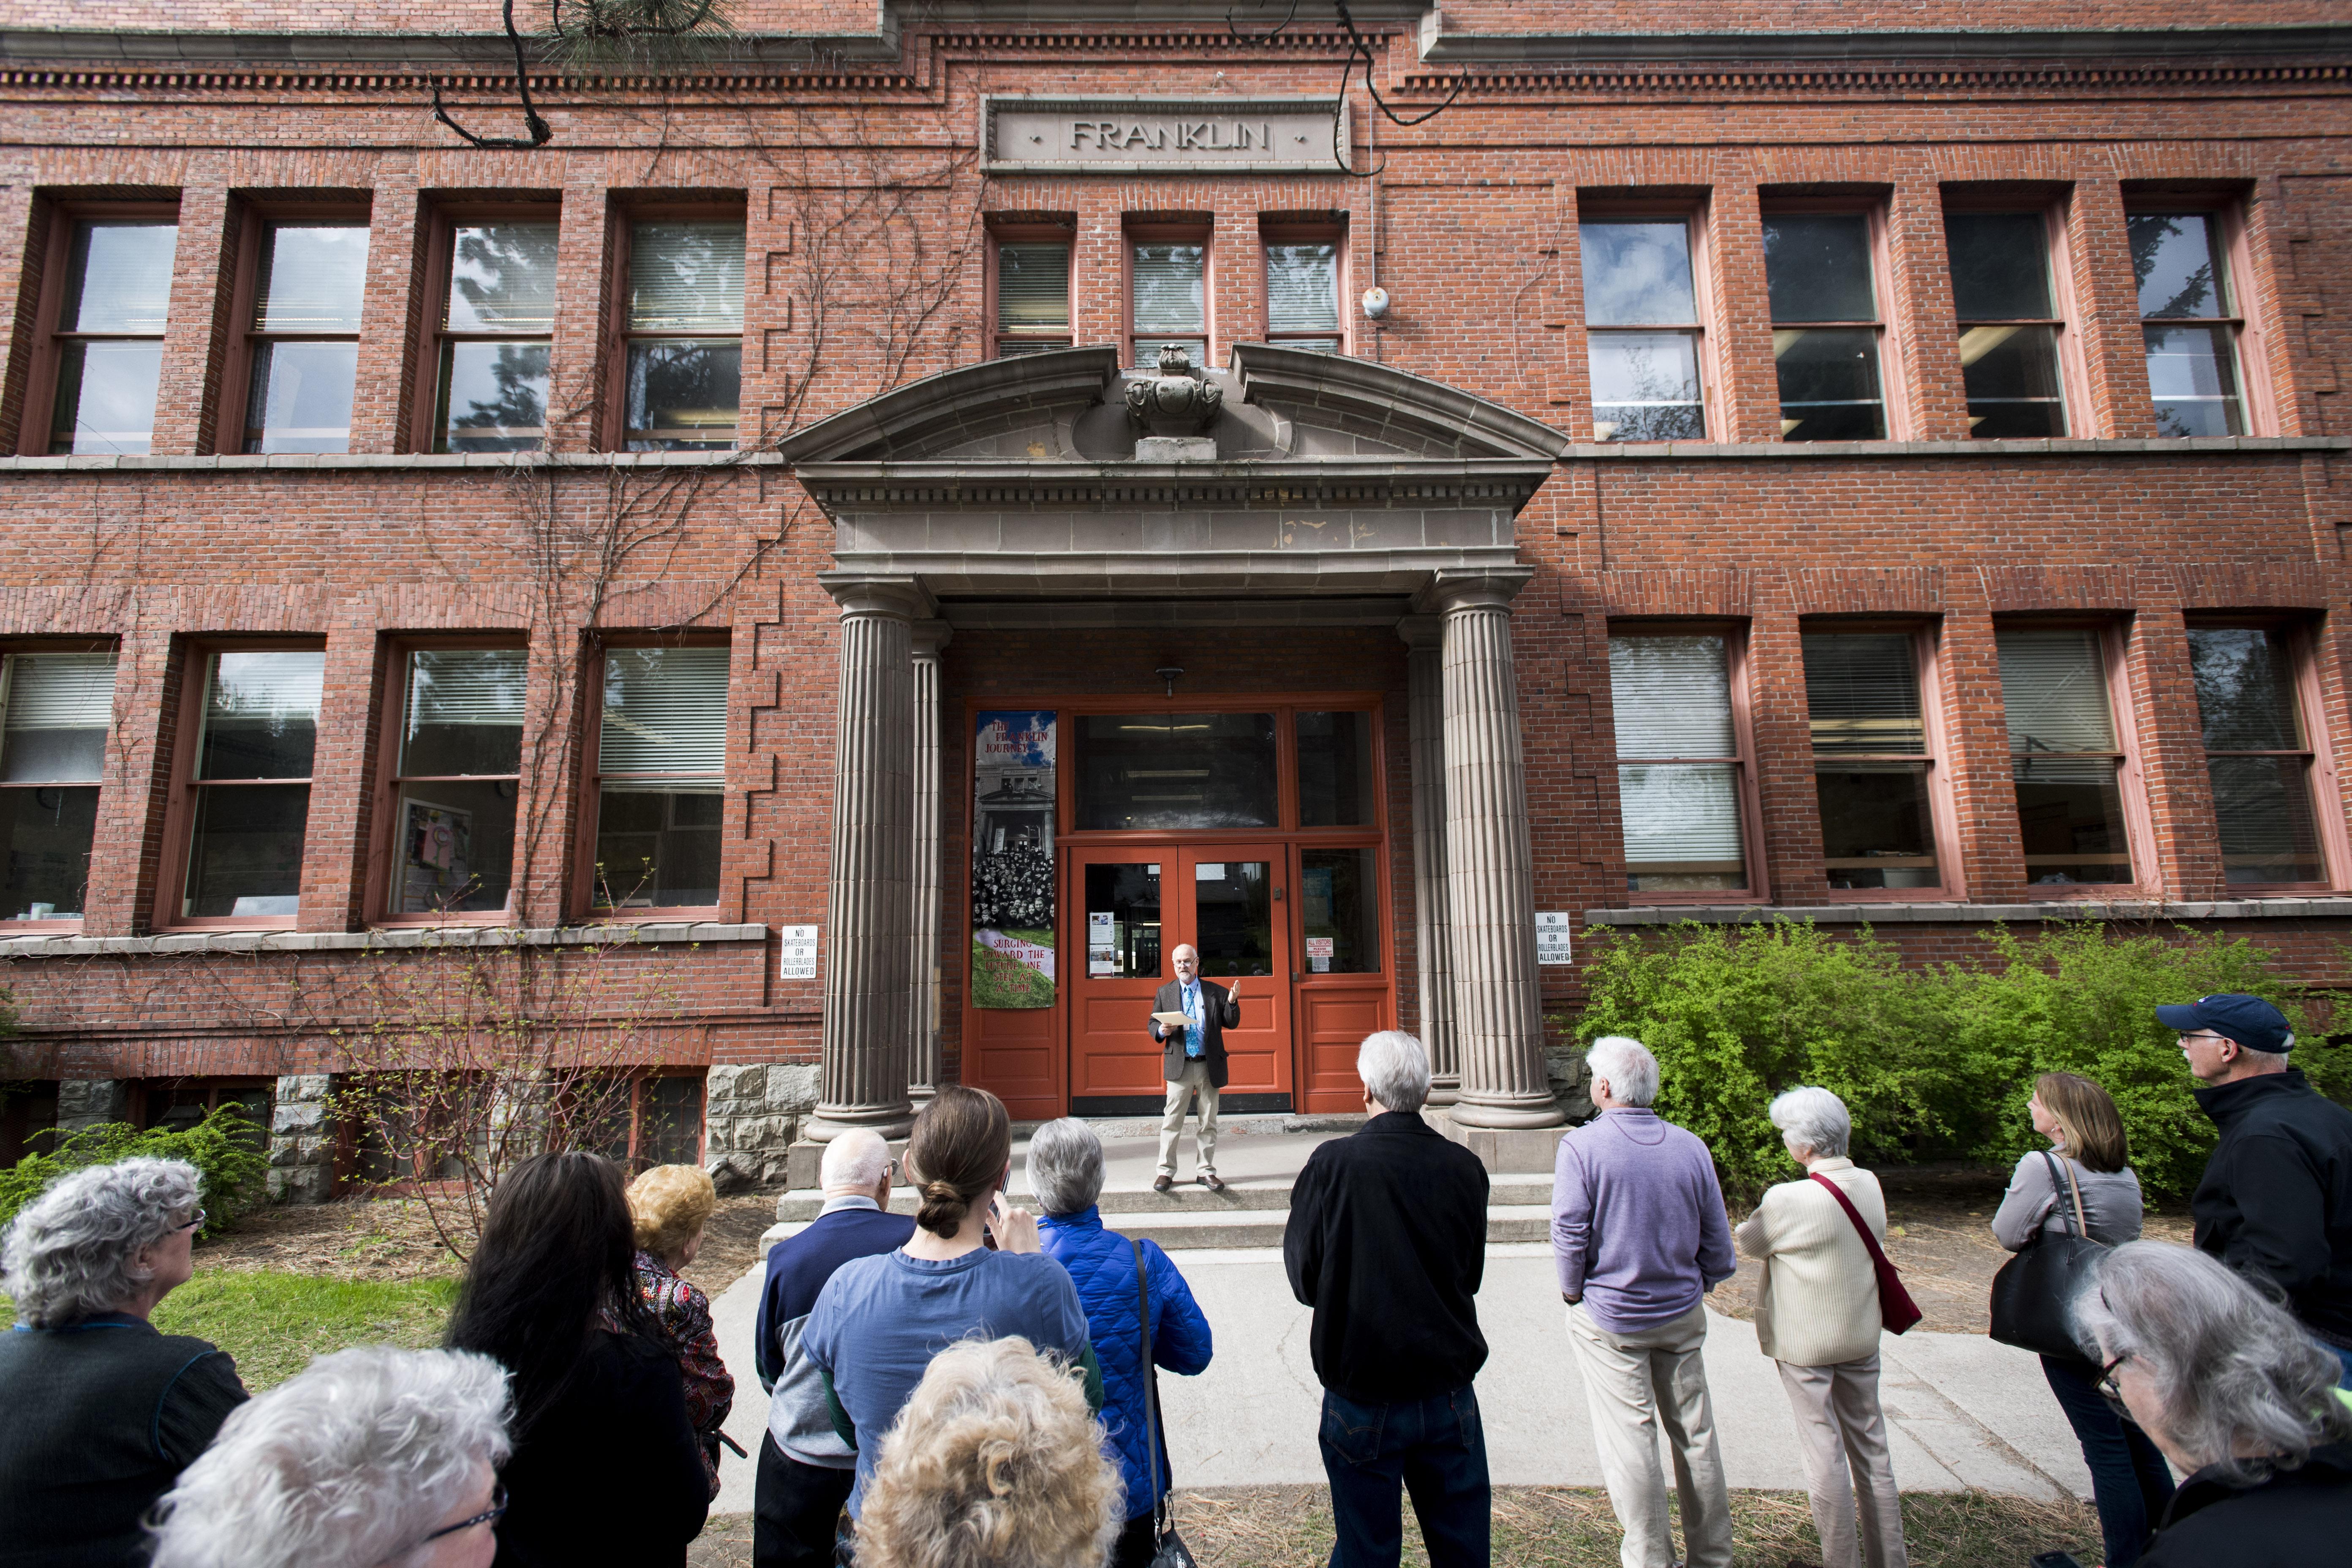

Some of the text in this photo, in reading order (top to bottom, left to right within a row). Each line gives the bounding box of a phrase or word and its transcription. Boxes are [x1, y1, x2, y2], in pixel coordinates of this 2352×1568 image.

[1070, 121, 1270, 149] FRANKLIN
[991, 721, 1010, 731] THE
[995, 732, 1048, 741] FRANKLIN
[795, 929, 804, 937] NO
[1537, 925, 1568, 933] SKATEBOARDS
[784, 939, 815, 947] SKATEBOARDS
[994, 939, 1032, 948] SURGING
[1538, 943, 1568, 951] ROLLERBLADES
[983, 950, 1045, 959] TOWARD THE
[1540, 953, 1569, 961] ALLOWED
[784, 958, 814, 966] ROLLERBLADES
[985, 961, 1041, 970] FUTURE ONE
[993, 972, 1032, 981] STEP AT
[996, 984, 1031, 993] A TIME
